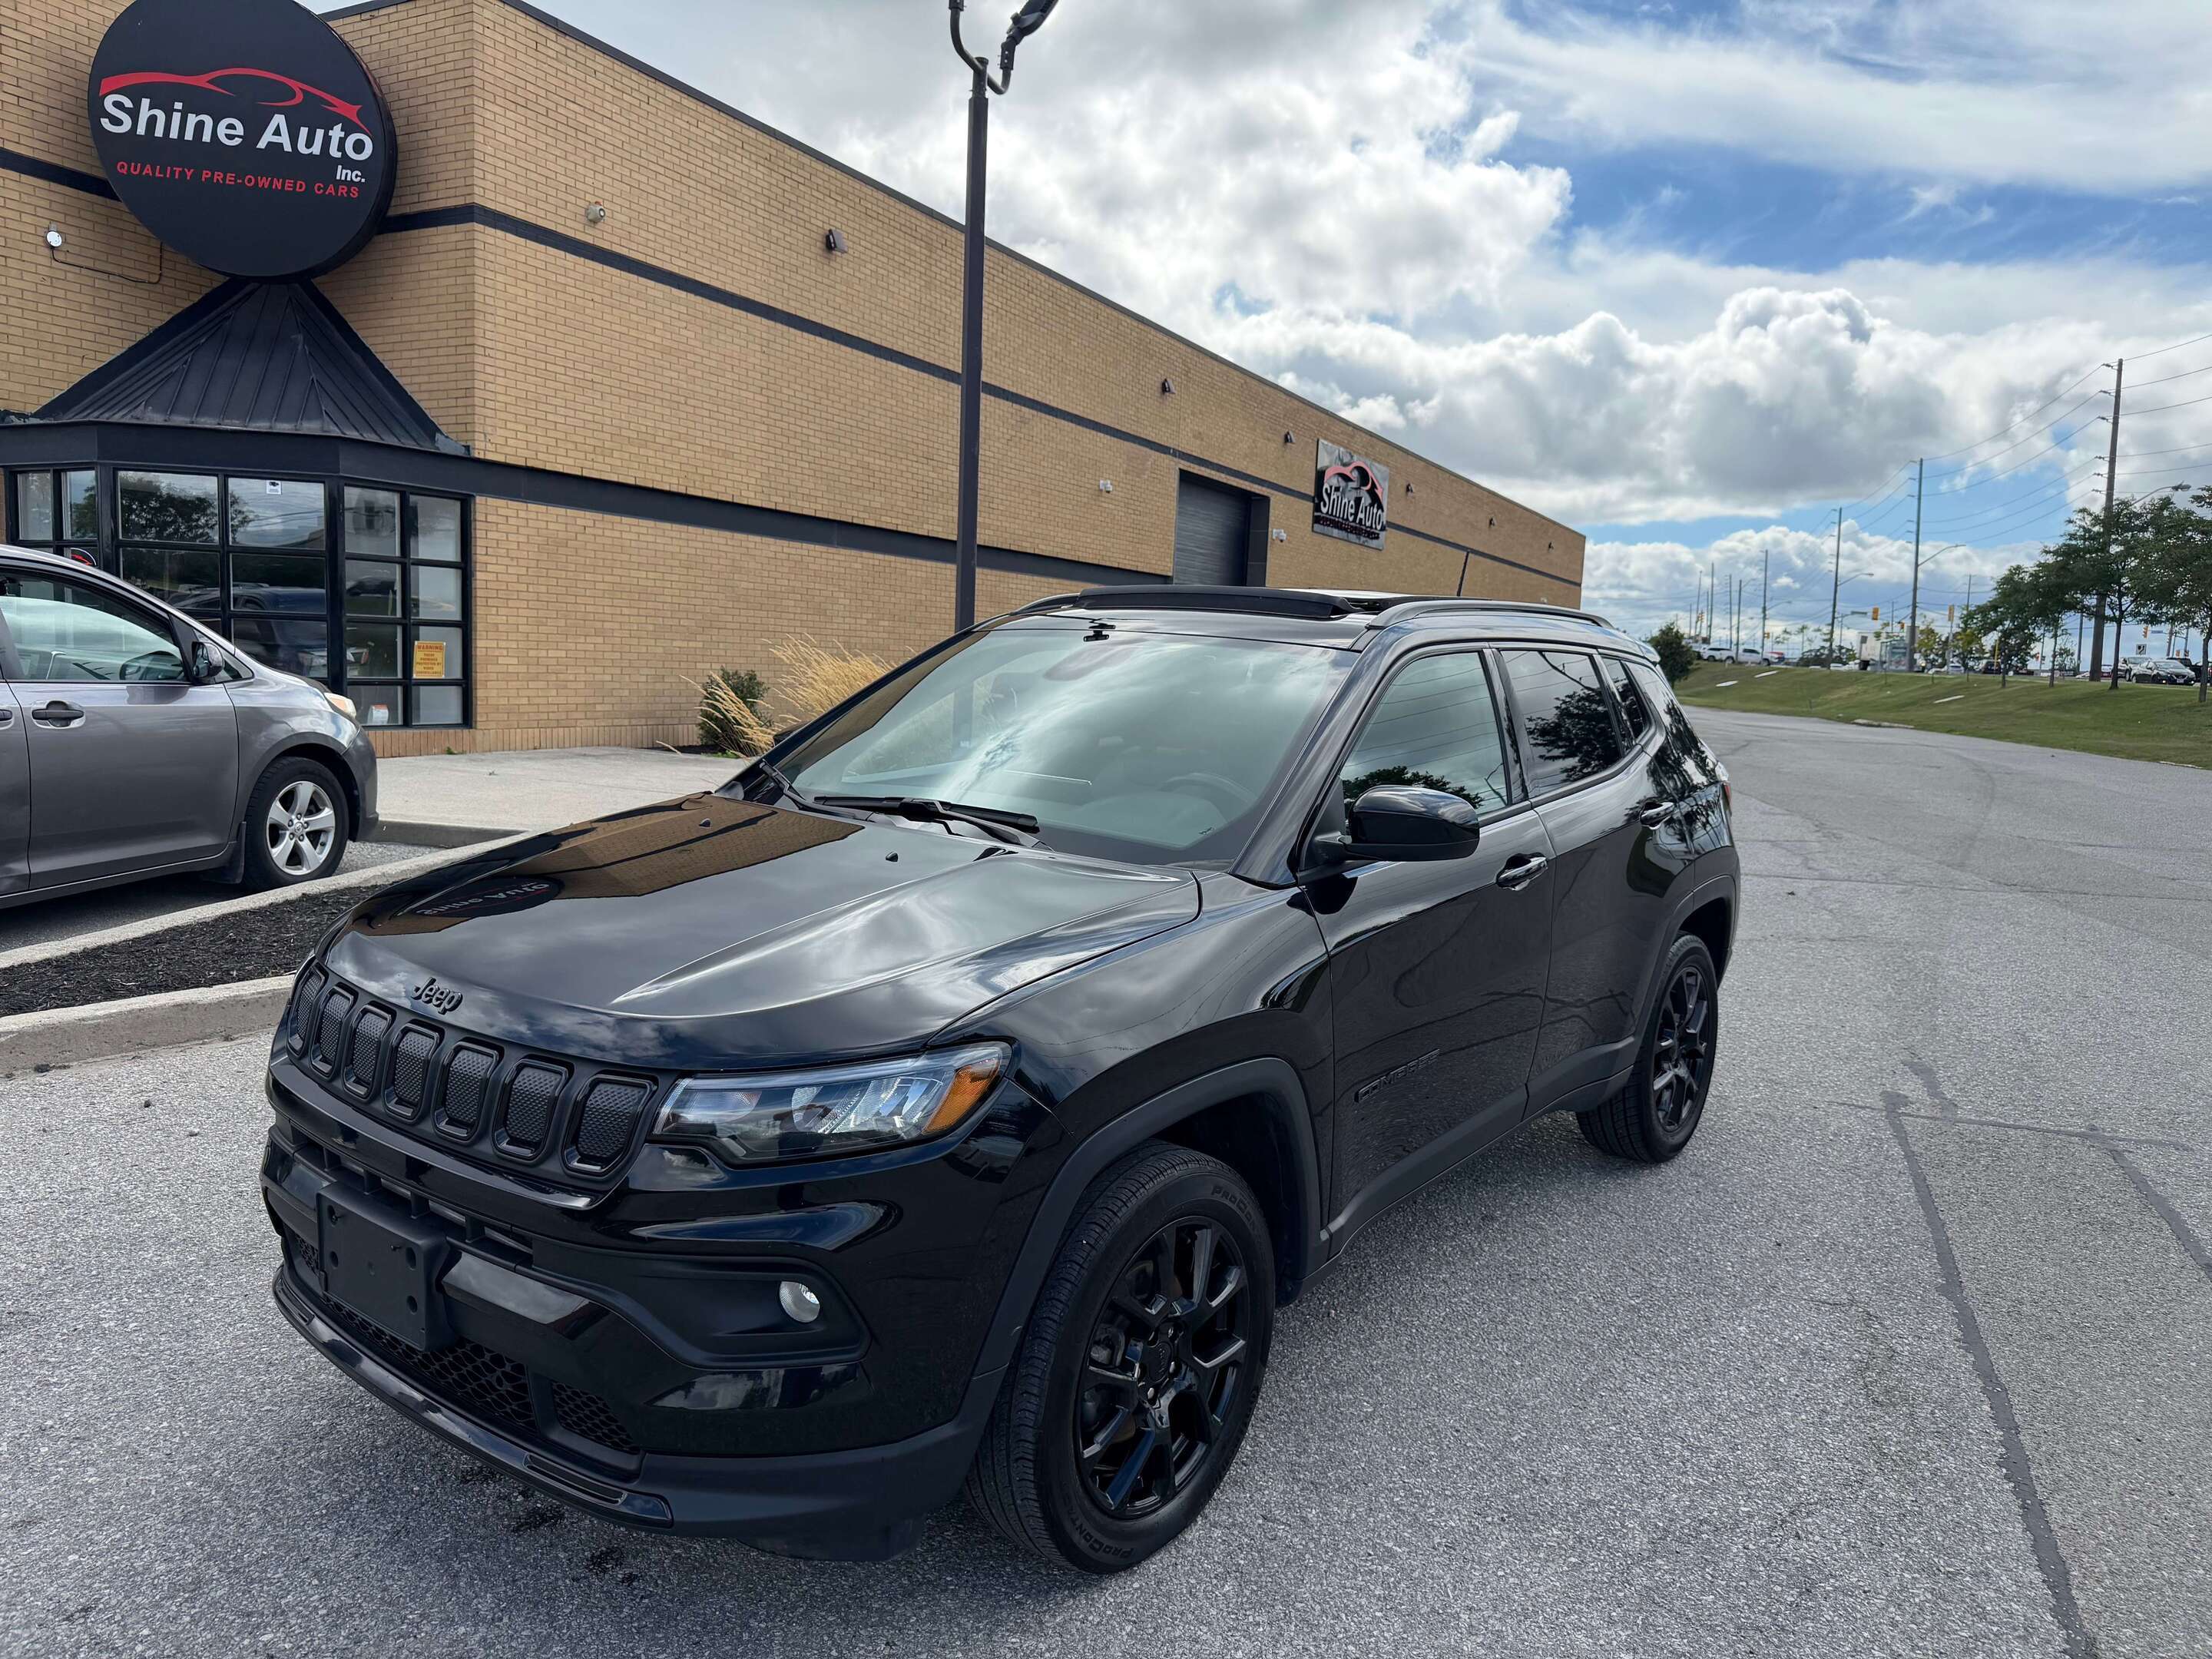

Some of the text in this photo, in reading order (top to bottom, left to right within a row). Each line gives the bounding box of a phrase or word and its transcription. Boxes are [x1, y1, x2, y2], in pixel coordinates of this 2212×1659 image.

[100, 94, 373, 161] Shine Auto
[117, 161, 359, 198] QUALITY PRE-OWNED CARS
[336, 164, 366, 183] Inc.
[1320, 482, 1356, 522] Shine
[1356, 496, 1382, 530] Auto
[411, 976, 463, 1015] Jeep
